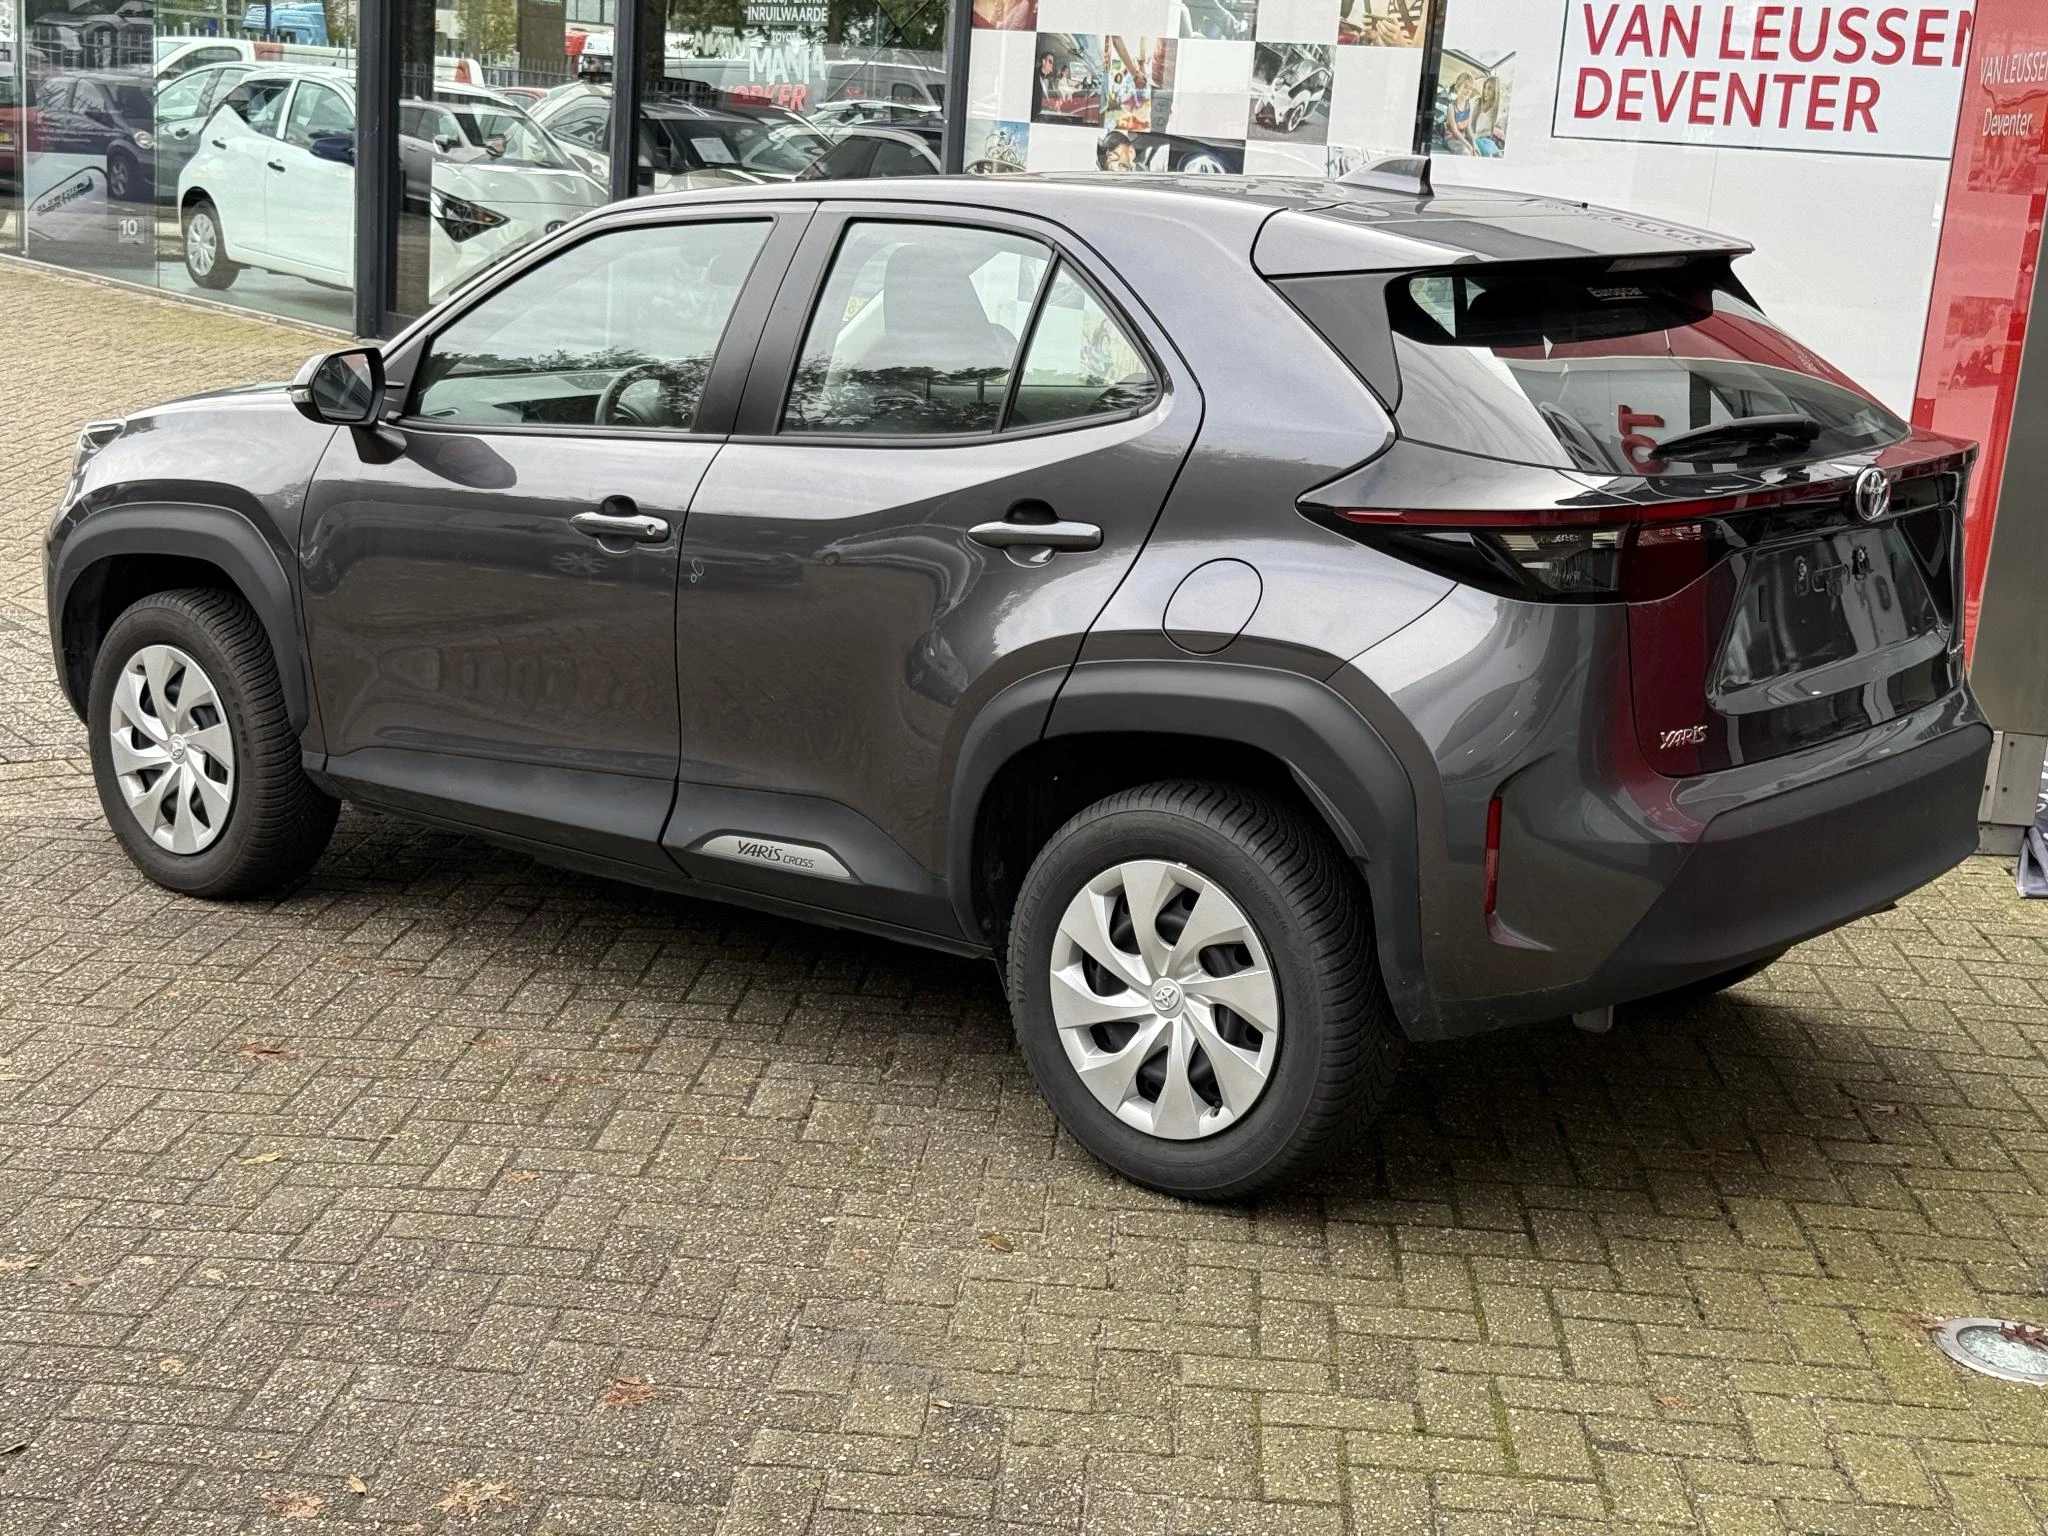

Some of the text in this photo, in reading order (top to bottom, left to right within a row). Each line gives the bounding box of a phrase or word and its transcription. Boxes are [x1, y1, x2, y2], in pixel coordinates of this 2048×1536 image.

[747, 6, 829, 22] INRUILWAARDE
[771, 32, 802, 43] TOYOTA
[1583, 4, 1701, 59] VAN
[749, 43, 826, 85] MANIA
[1980, 55, 2003, 85] VAN
[1573, 67, 1881, 133] DEVENTER
[1982, 107, 2032, 137] Deventer
[120, 219, 138, 235] 10
[783, 855, 815, 869] CROSS
